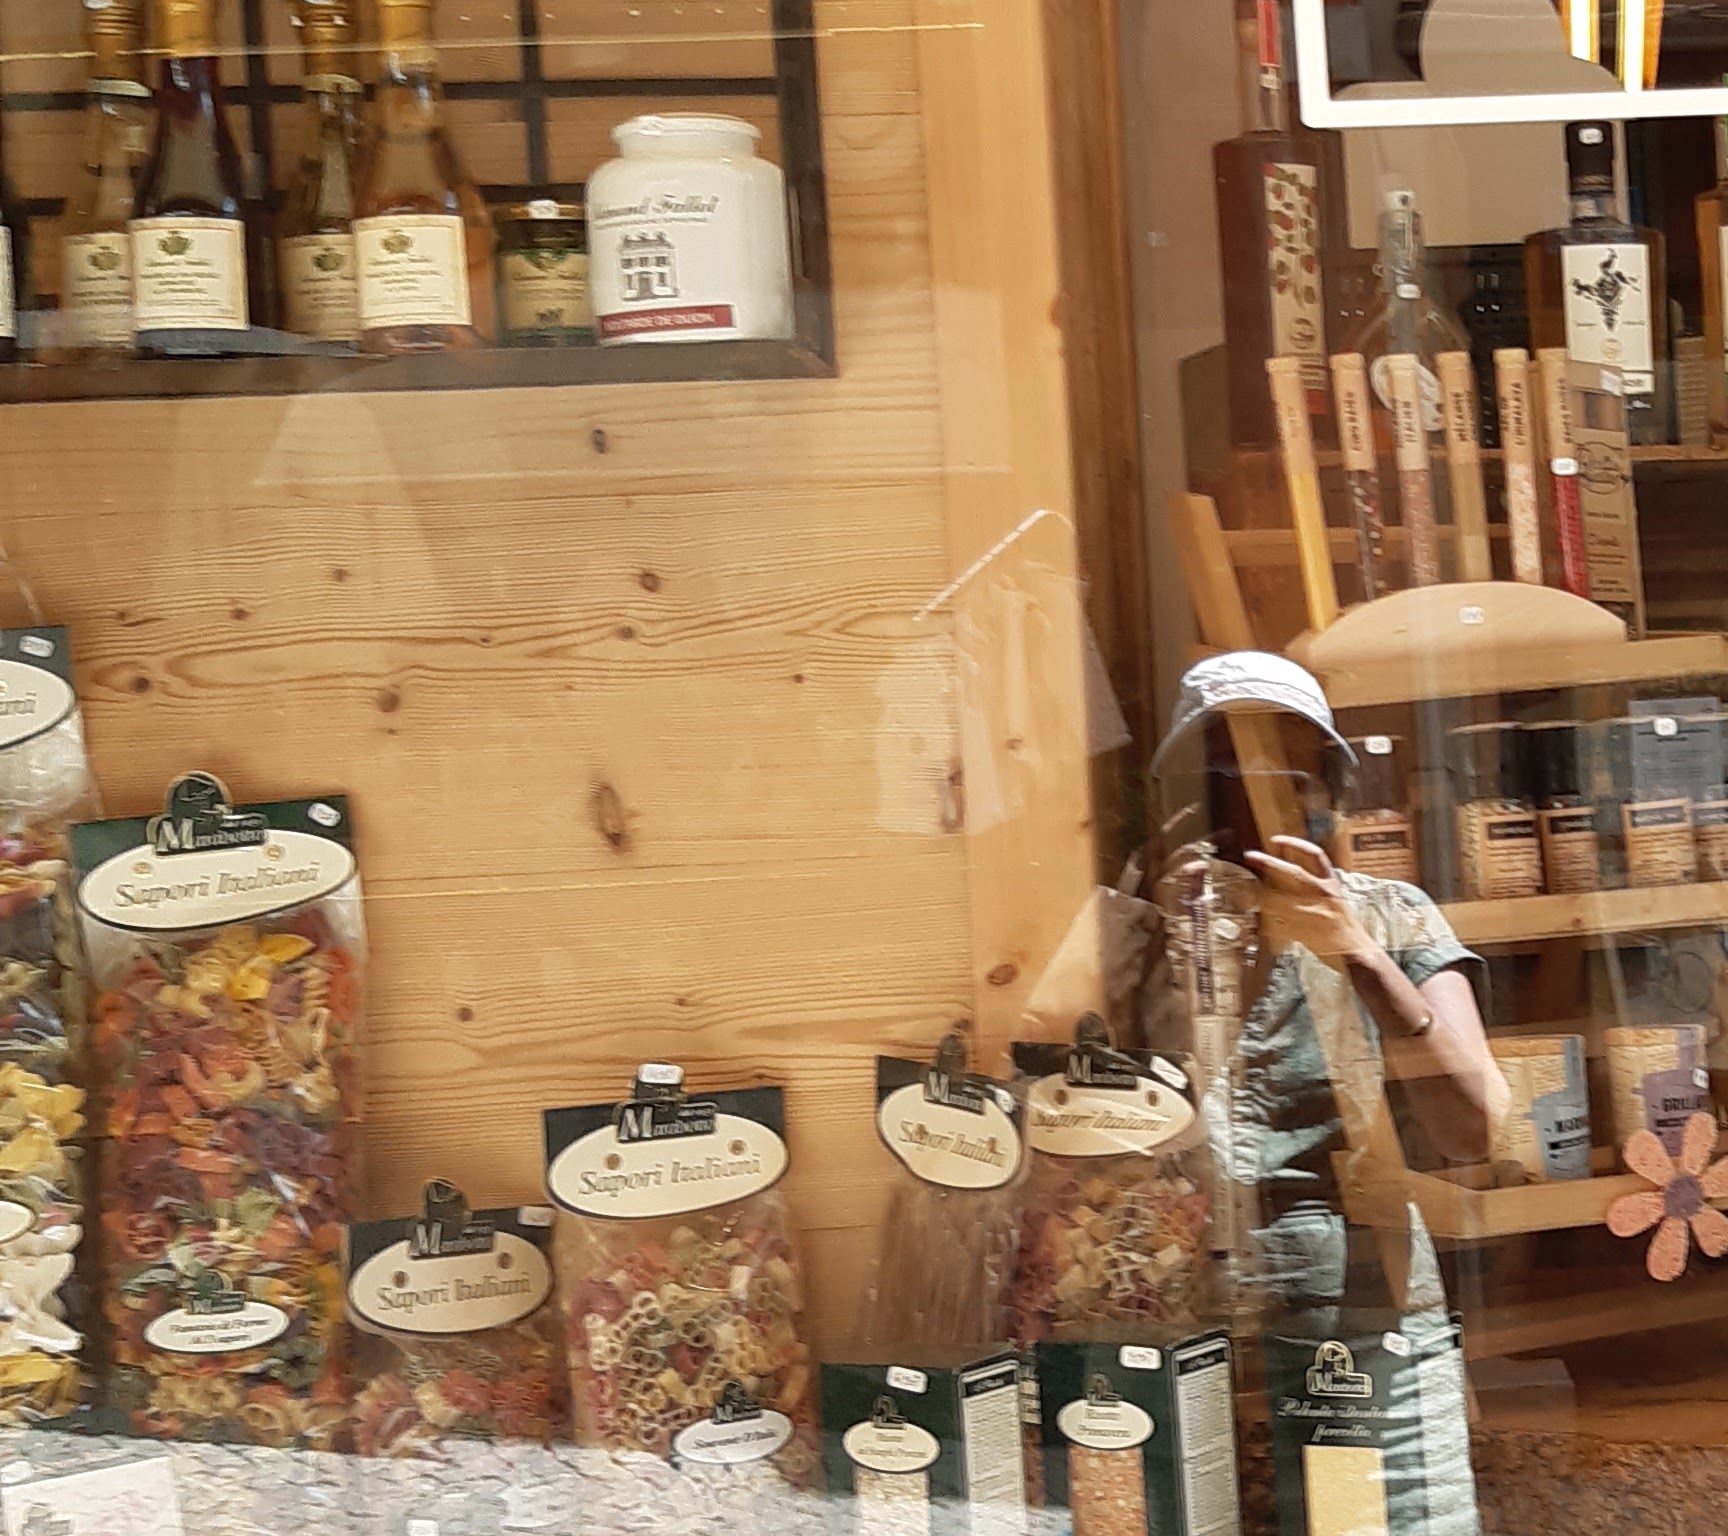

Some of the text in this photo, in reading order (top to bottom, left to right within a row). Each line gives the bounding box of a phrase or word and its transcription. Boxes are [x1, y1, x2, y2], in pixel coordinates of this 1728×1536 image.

[114, 860, 322, 909] Sapori Italiani
[577, 1152, 763, 1198] Sapori Italiani
[376, 1270, 533, 1314] Sapori Italiani
